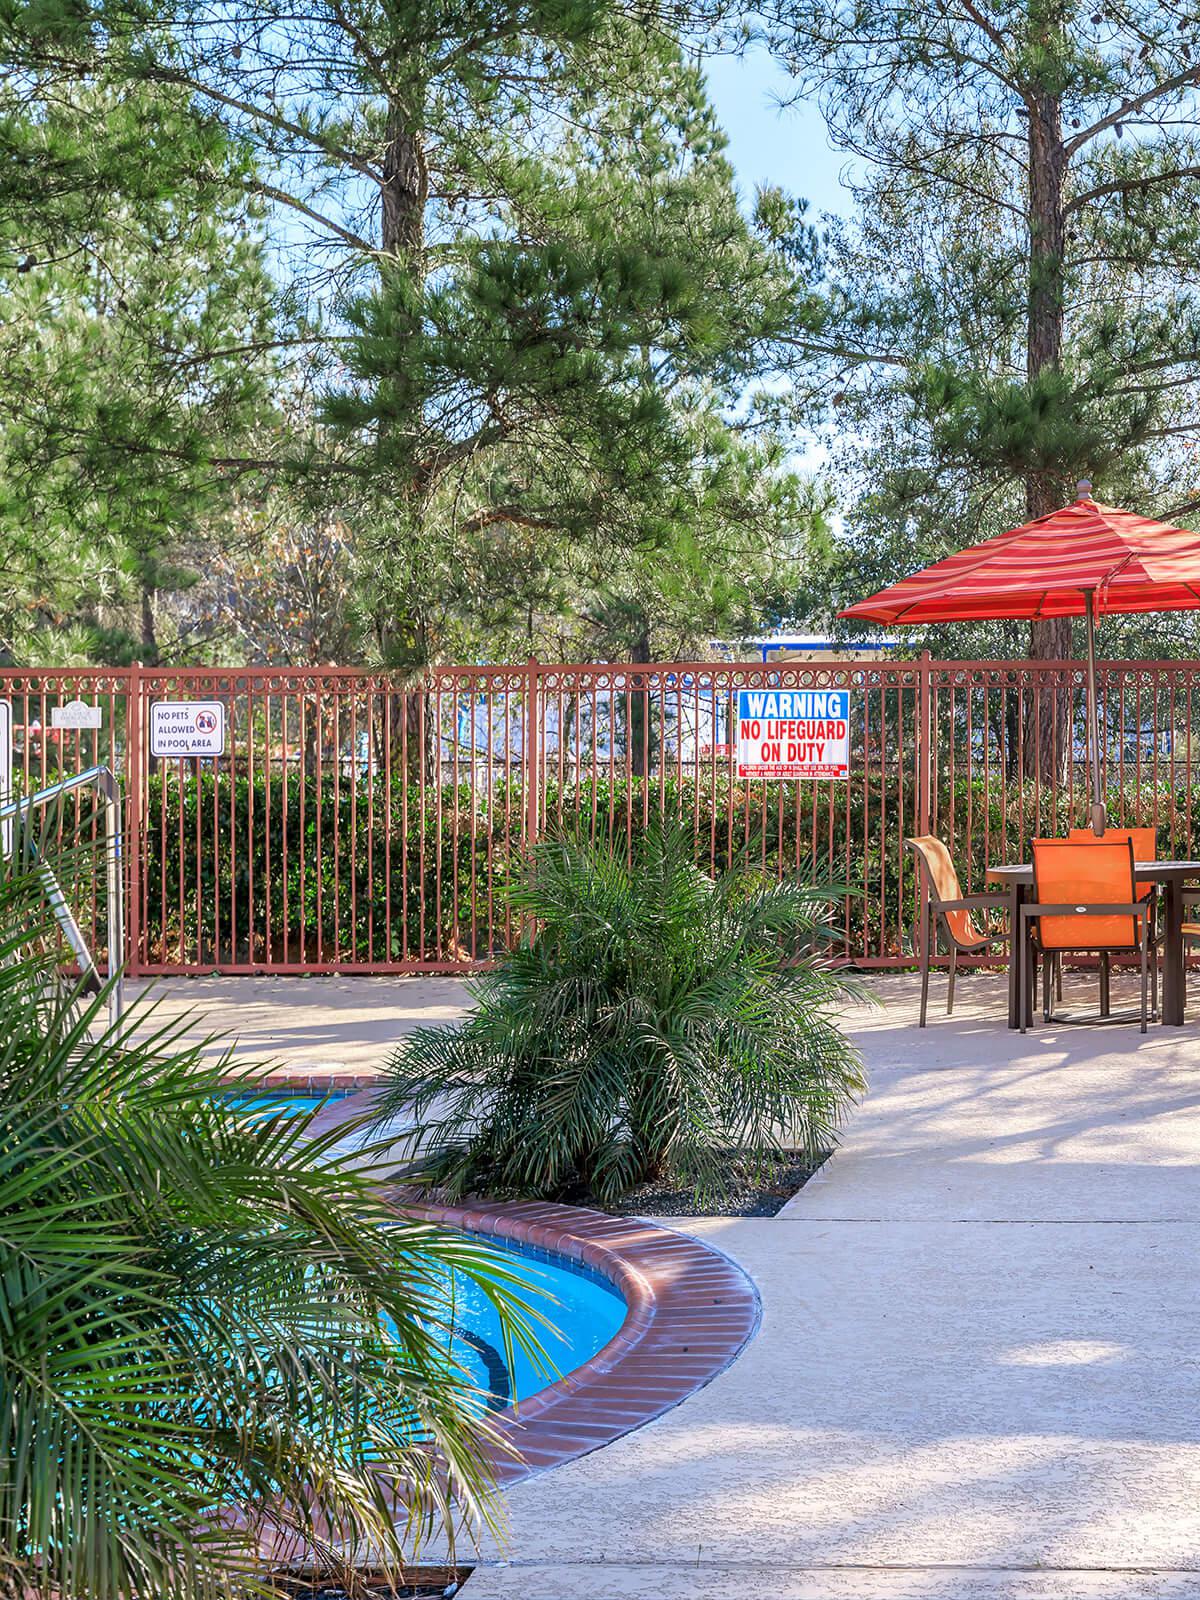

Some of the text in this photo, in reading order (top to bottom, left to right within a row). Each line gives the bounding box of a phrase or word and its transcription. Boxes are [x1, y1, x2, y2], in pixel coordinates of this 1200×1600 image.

[747, 692, 841, 719] WARNING
[157, 711, 189, 720] NO PETS
[158, 725, 196, 734] ALLOWED
[741, 720, 846, 740] NO LIFEGUARD
[157, 739, 212, 748] IN POOL AREA
[761, 742, 826, 762] ON DUTY
